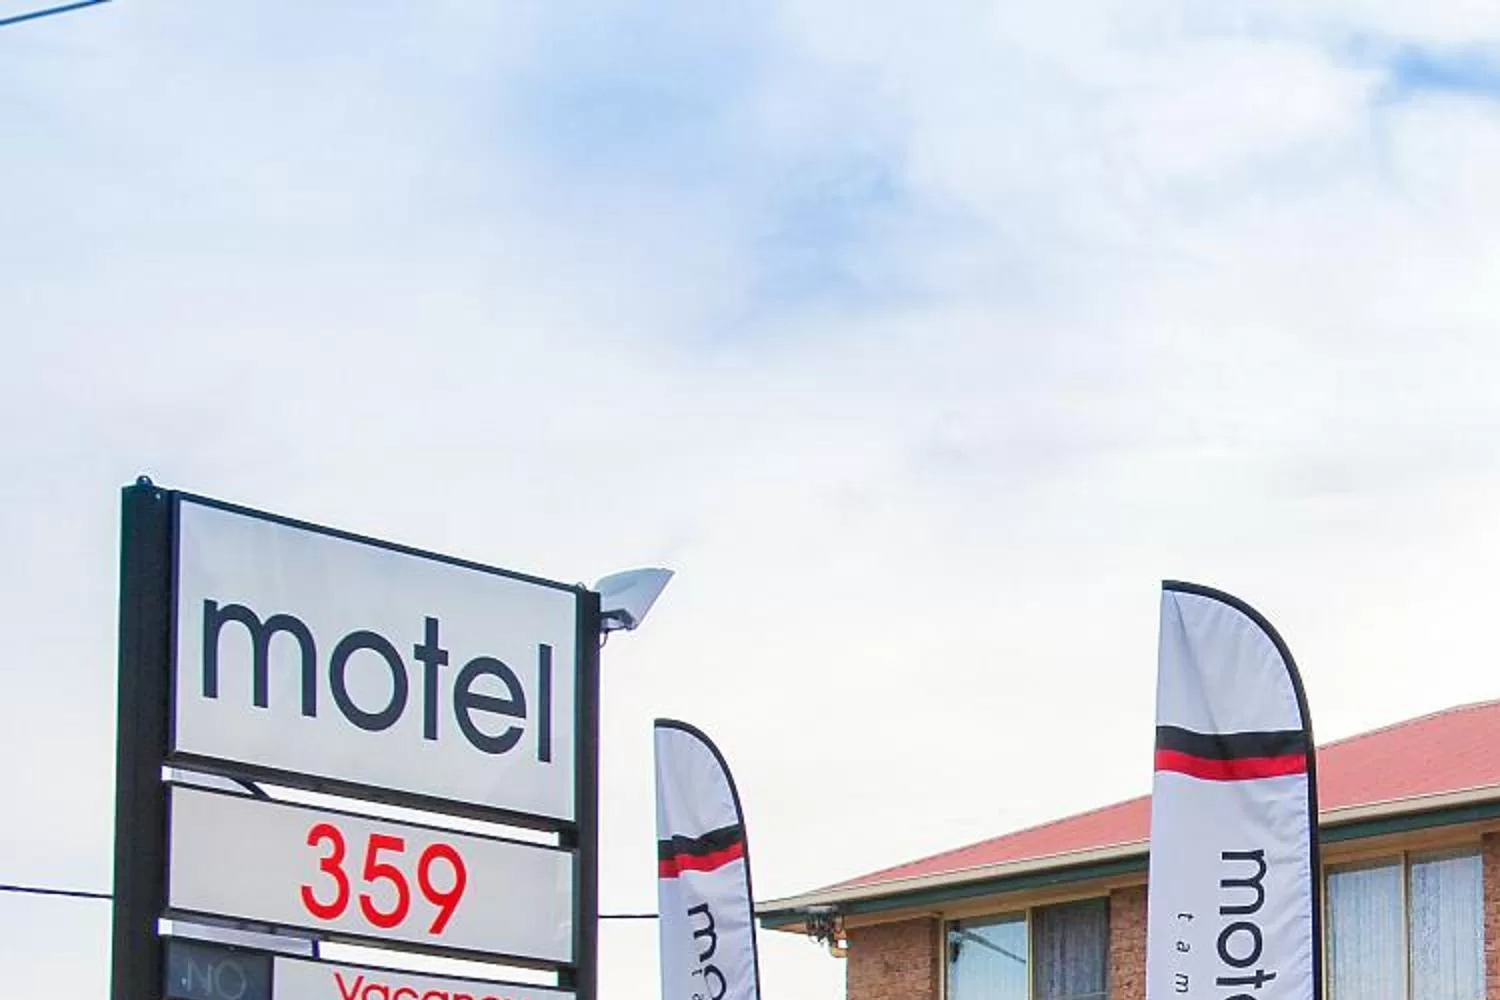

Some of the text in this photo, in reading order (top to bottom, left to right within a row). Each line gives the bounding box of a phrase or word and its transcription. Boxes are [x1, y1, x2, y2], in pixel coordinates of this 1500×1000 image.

[202, 598, 552, 763] motel
[300, 823, 467, 934] 359
[187, 958, 247, 1000] NO
